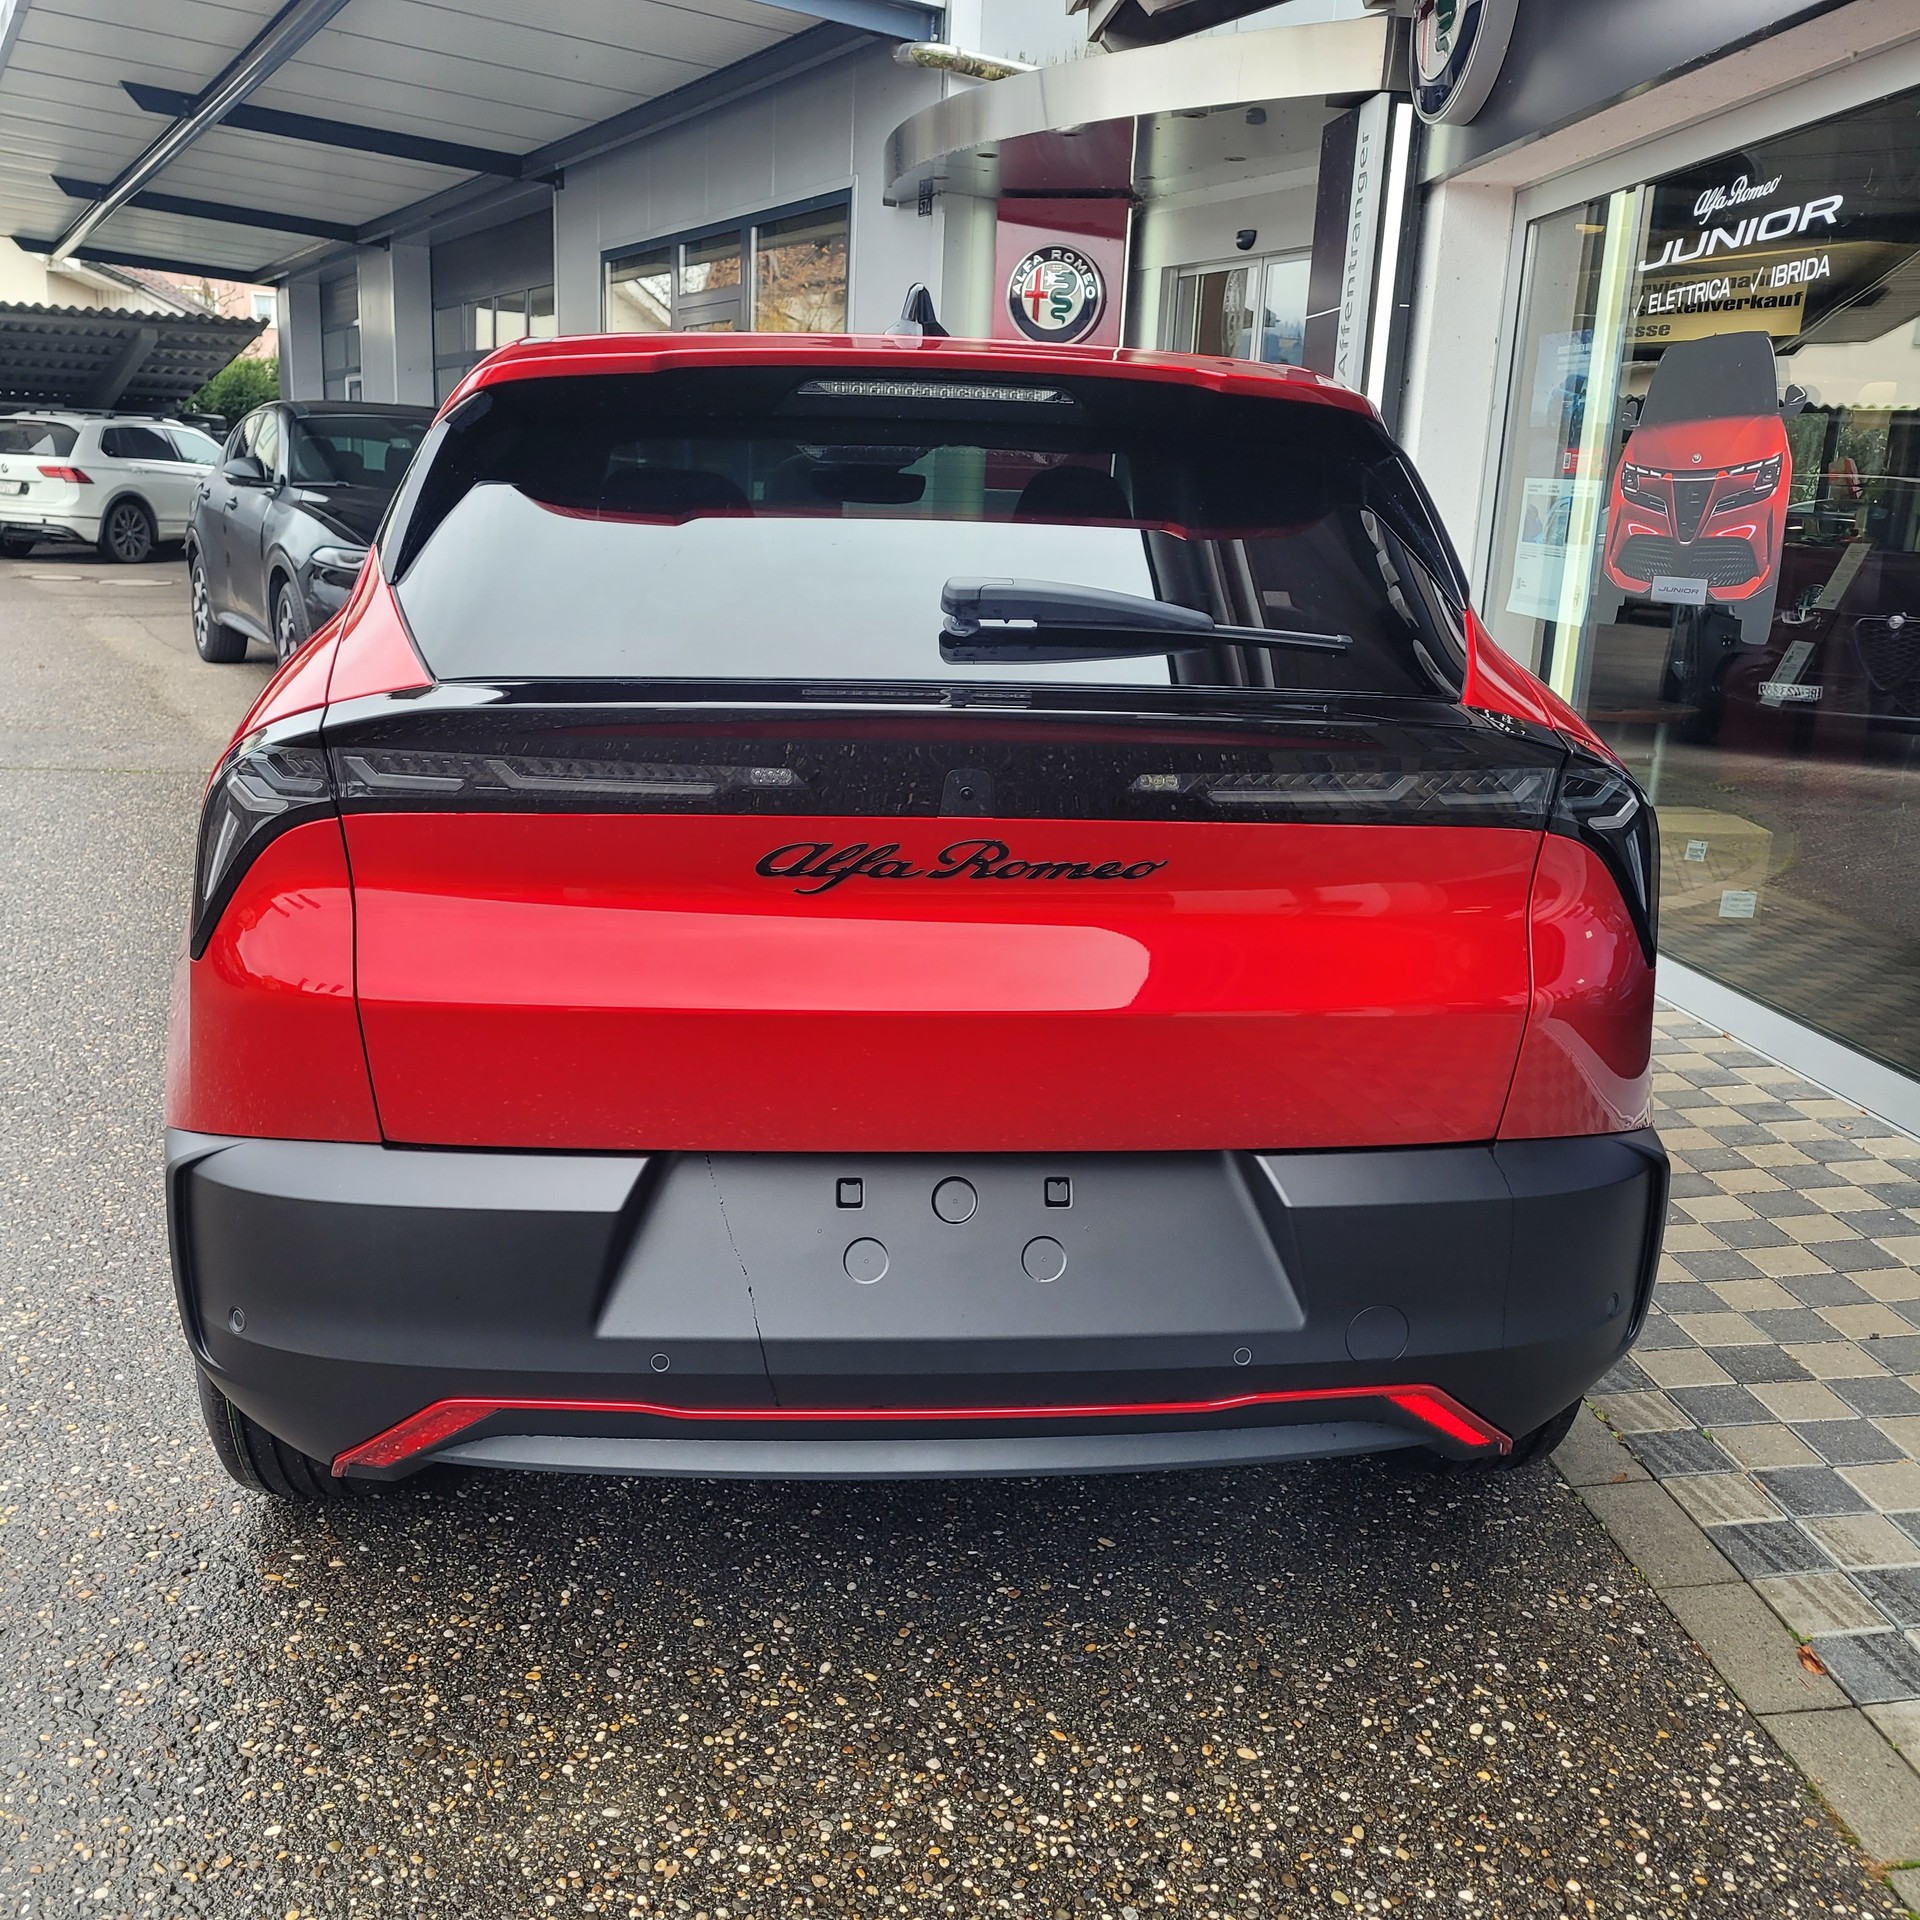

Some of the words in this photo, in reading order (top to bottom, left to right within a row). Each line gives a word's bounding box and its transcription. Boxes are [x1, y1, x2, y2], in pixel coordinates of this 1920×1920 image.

[1693, 185, 1729, 226] Alfa
[1727, 174, 1783, 209] Romeo
[1337, 132, 1370, 377] Affentranger
[1638, 194, 1844, 272] JUNIOR
[1012, 254, 1045, 295] ALFA
[1051, 249, 1096, 299] ROMEO
[1647, 276, 1731, 314] ELETTRICA
[1769, 254, 1831, 289] IBRIDA
[1658, 586, 1700, 595] JUNIOR
[755, 842, 925, 895] Alfa
[925, 838, 1169, 881] Romeo
